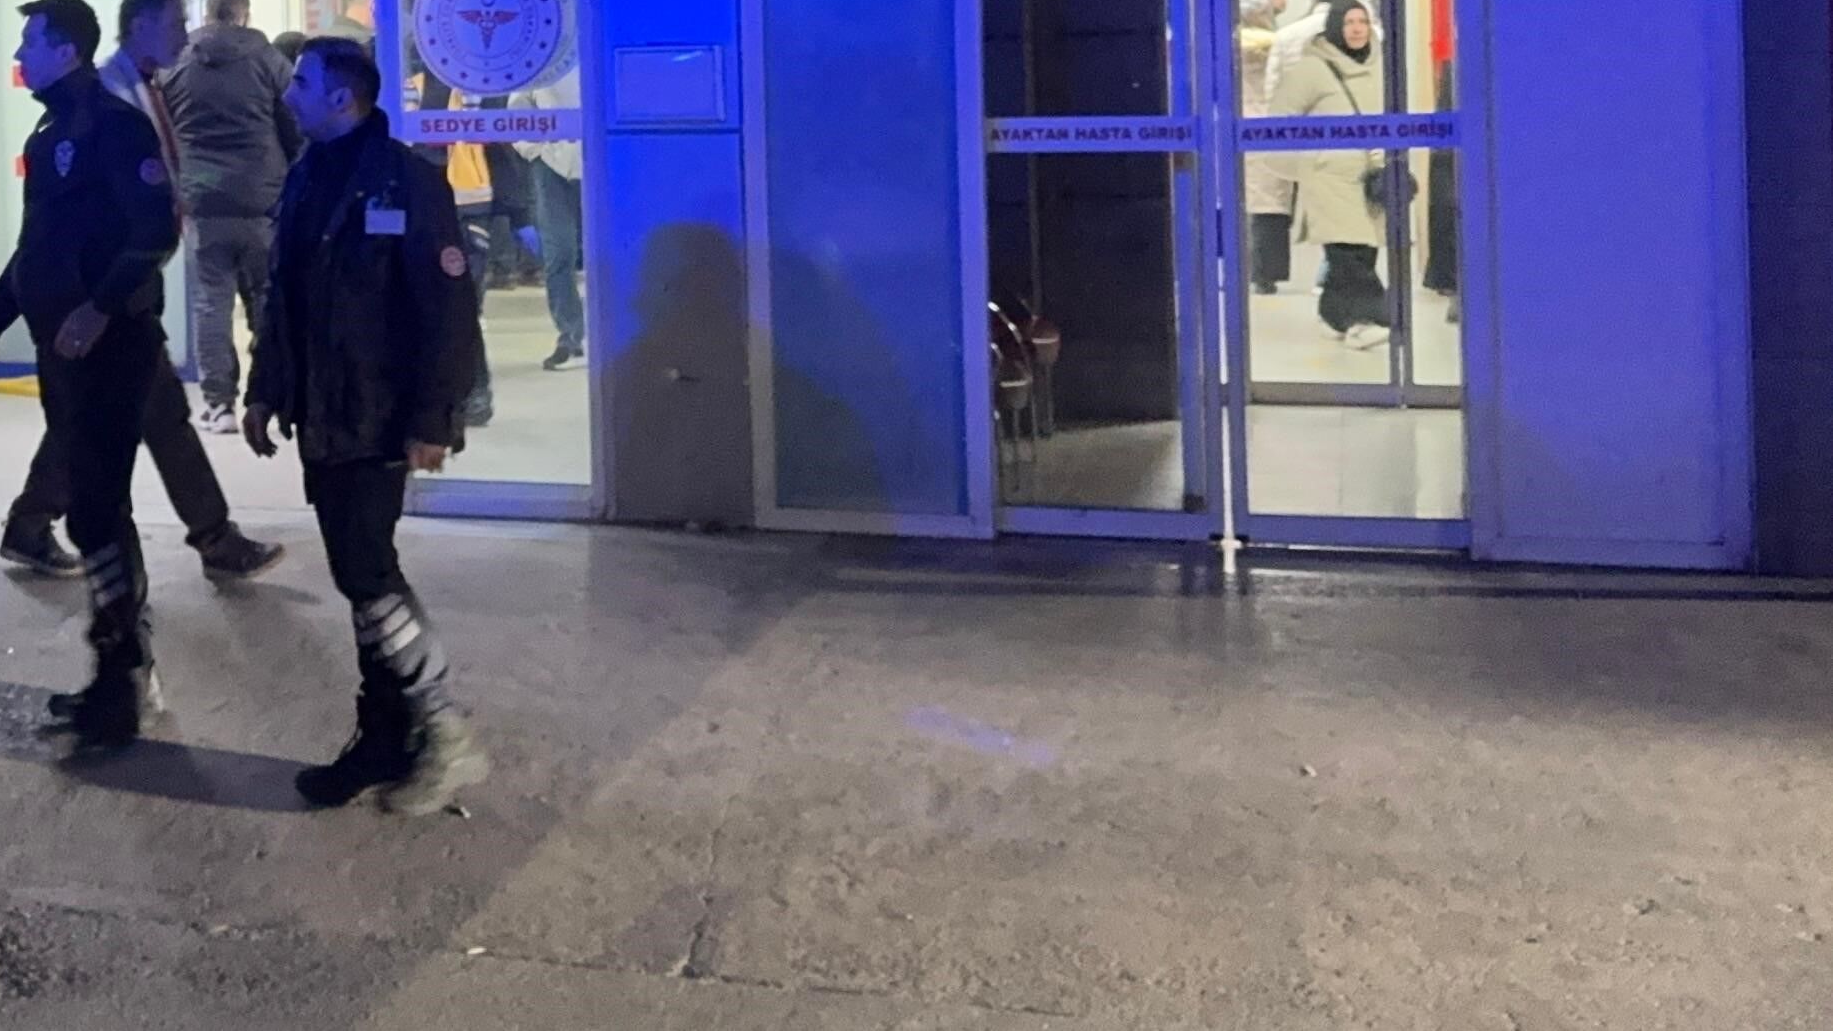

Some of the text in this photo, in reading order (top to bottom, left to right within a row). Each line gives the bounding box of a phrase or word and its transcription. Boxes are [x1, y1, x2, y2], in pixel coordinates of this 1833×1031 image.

[420, 113, 557, 136] SEDYE GİRİŞİ
[990, 124, 1193, 142] AYAKTAN HASTA GİRİŞİ
[1240, 121, 1454, 142] AYAKTAN HASTA GİRİŞİ
